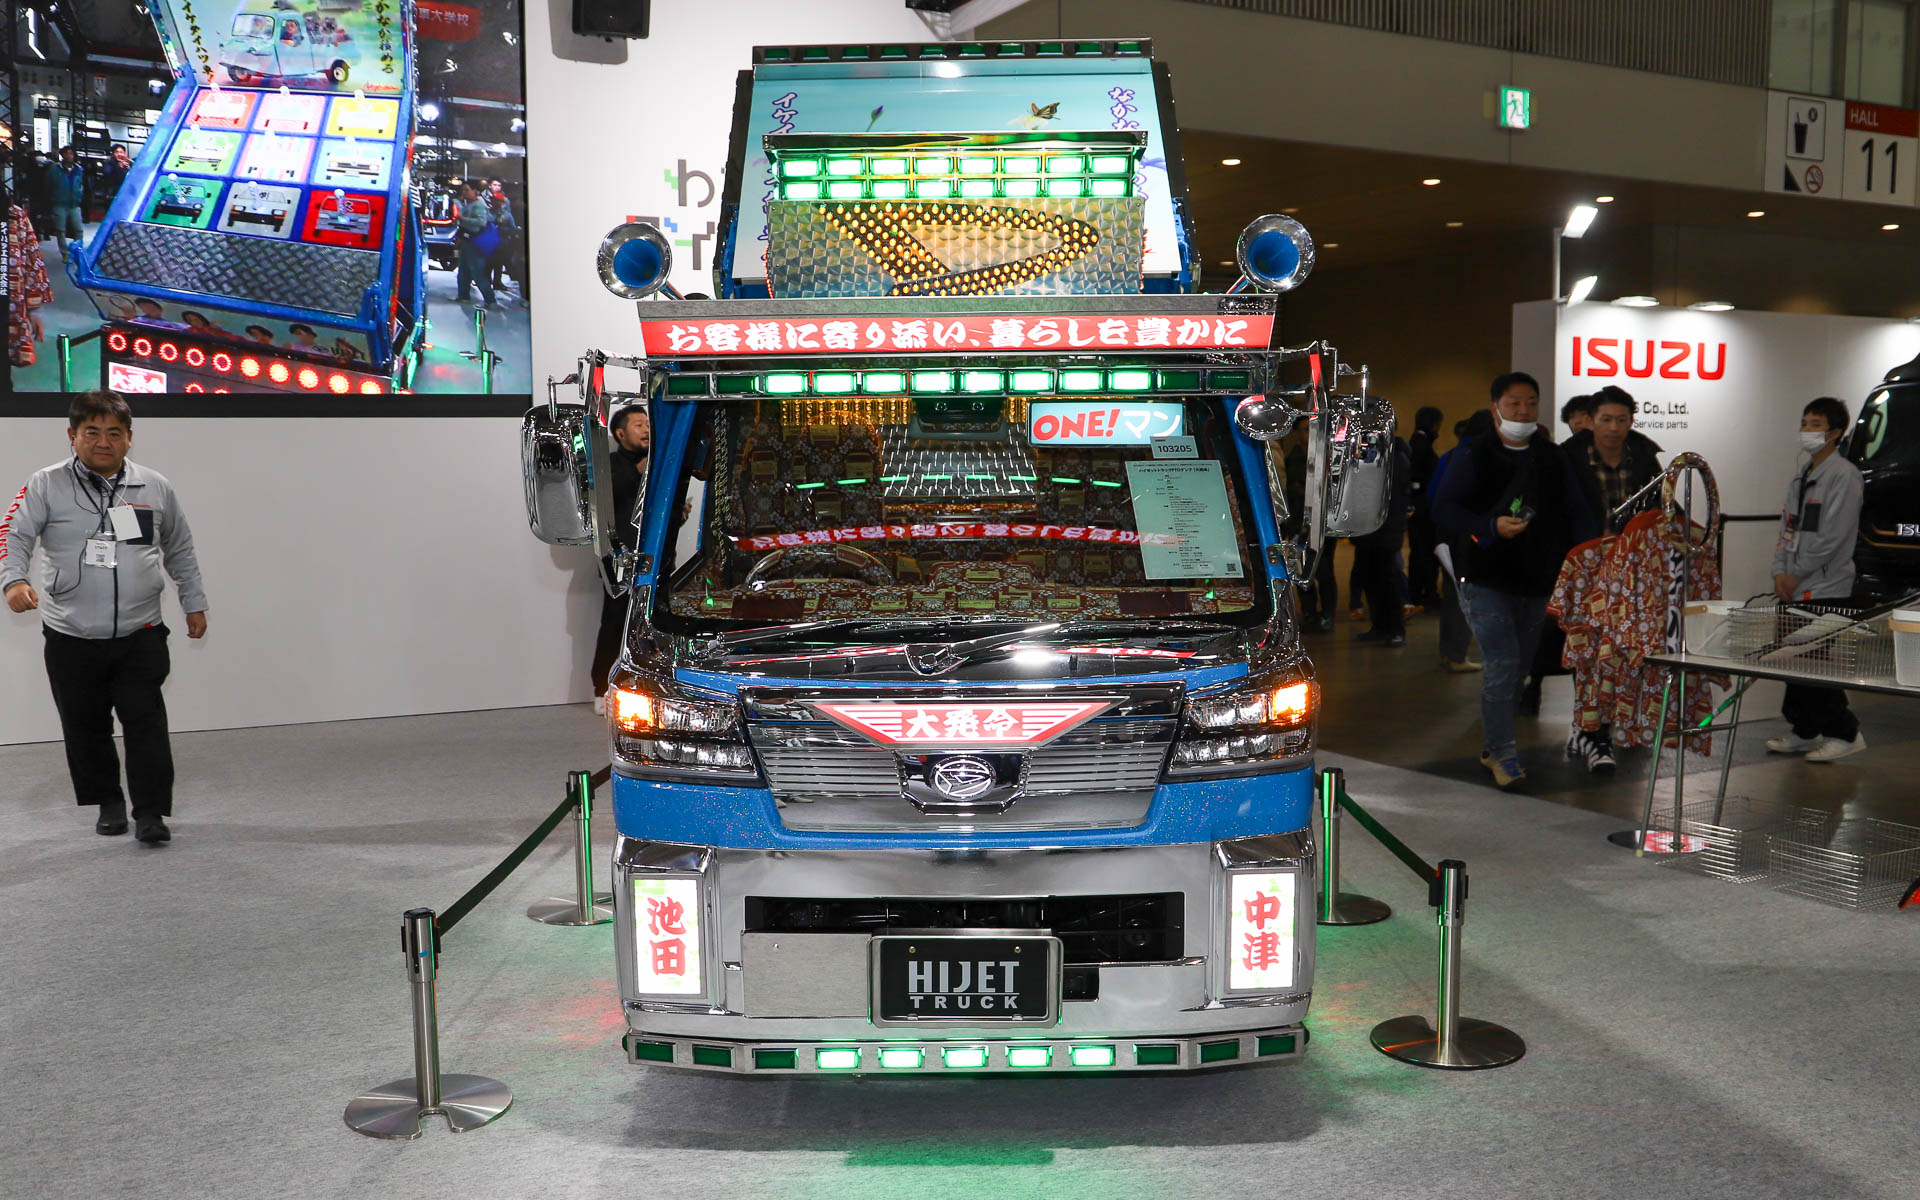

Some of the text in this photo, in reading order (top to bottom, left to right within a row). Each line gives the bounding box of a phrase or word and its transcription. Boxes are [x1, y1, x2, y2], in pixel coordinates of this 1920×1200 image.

[1850, 107, 1879, 127] HALL
[1861, 137, 1899, 195] 11
[666, 317, 1249, 353] お客様に寄り添い、暮らしを豊かに
[1572, 336, 1727, 380] ISUZU
[1643, 401, 1666, 416] Co.,
[1668, 400, 1690, 415] Ltd.
[1666, 420, 1689, 430] parts
[1157, 445, 1193, 453] 103205
[905, 709, 1020, 738] 大発命
[647, 896, 687, 977] 池田
[1242, 890, 1281, 971] 中津
[908, 960, 1020, 993] HIJET
[909, 995, 1018, 1010] TRUCK
